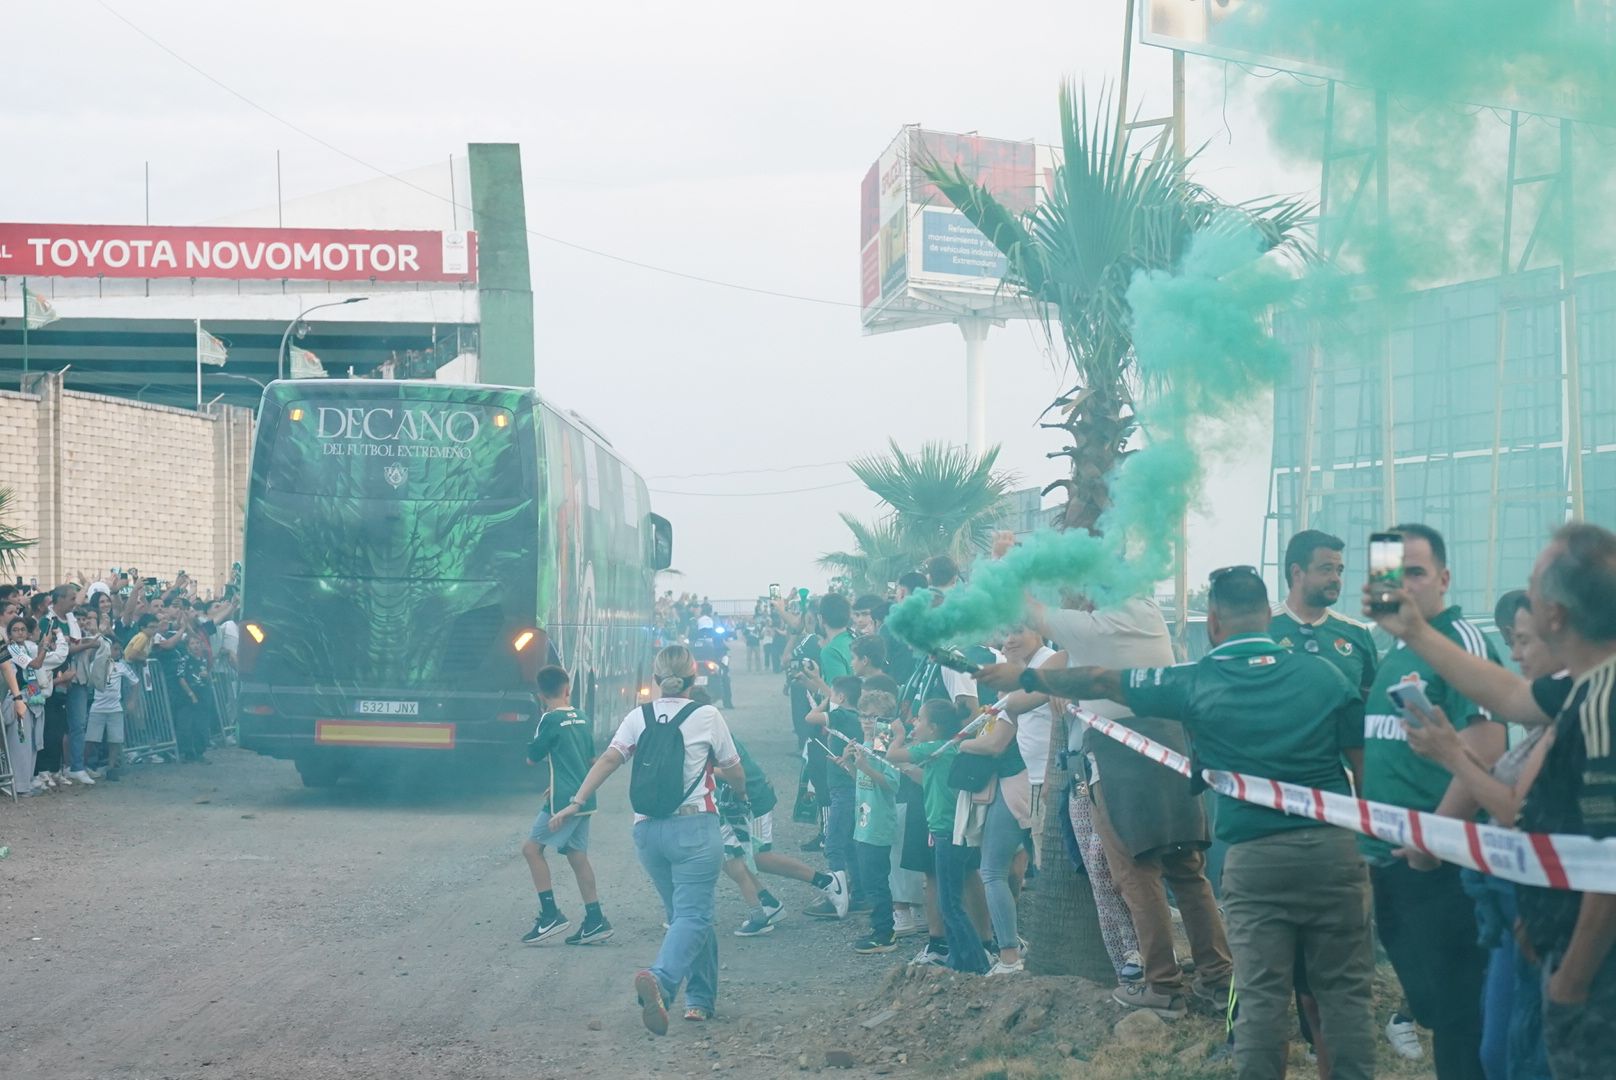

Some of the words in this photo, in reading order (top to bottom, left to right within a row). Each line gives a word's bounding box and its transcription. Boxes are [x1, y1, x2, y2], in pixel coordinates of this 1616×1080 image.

[0, 244, 13, 259] L
[28, 238, 177, 268] TOYOTA
[185, 241, 420, 272] NOVOMOTOR
[316, 407, 480, 443] DECANO
[323, 443, 345, 455] DEL
[362, 701, 390, 713] 5321
[394, 702, 416, 714] JNX
